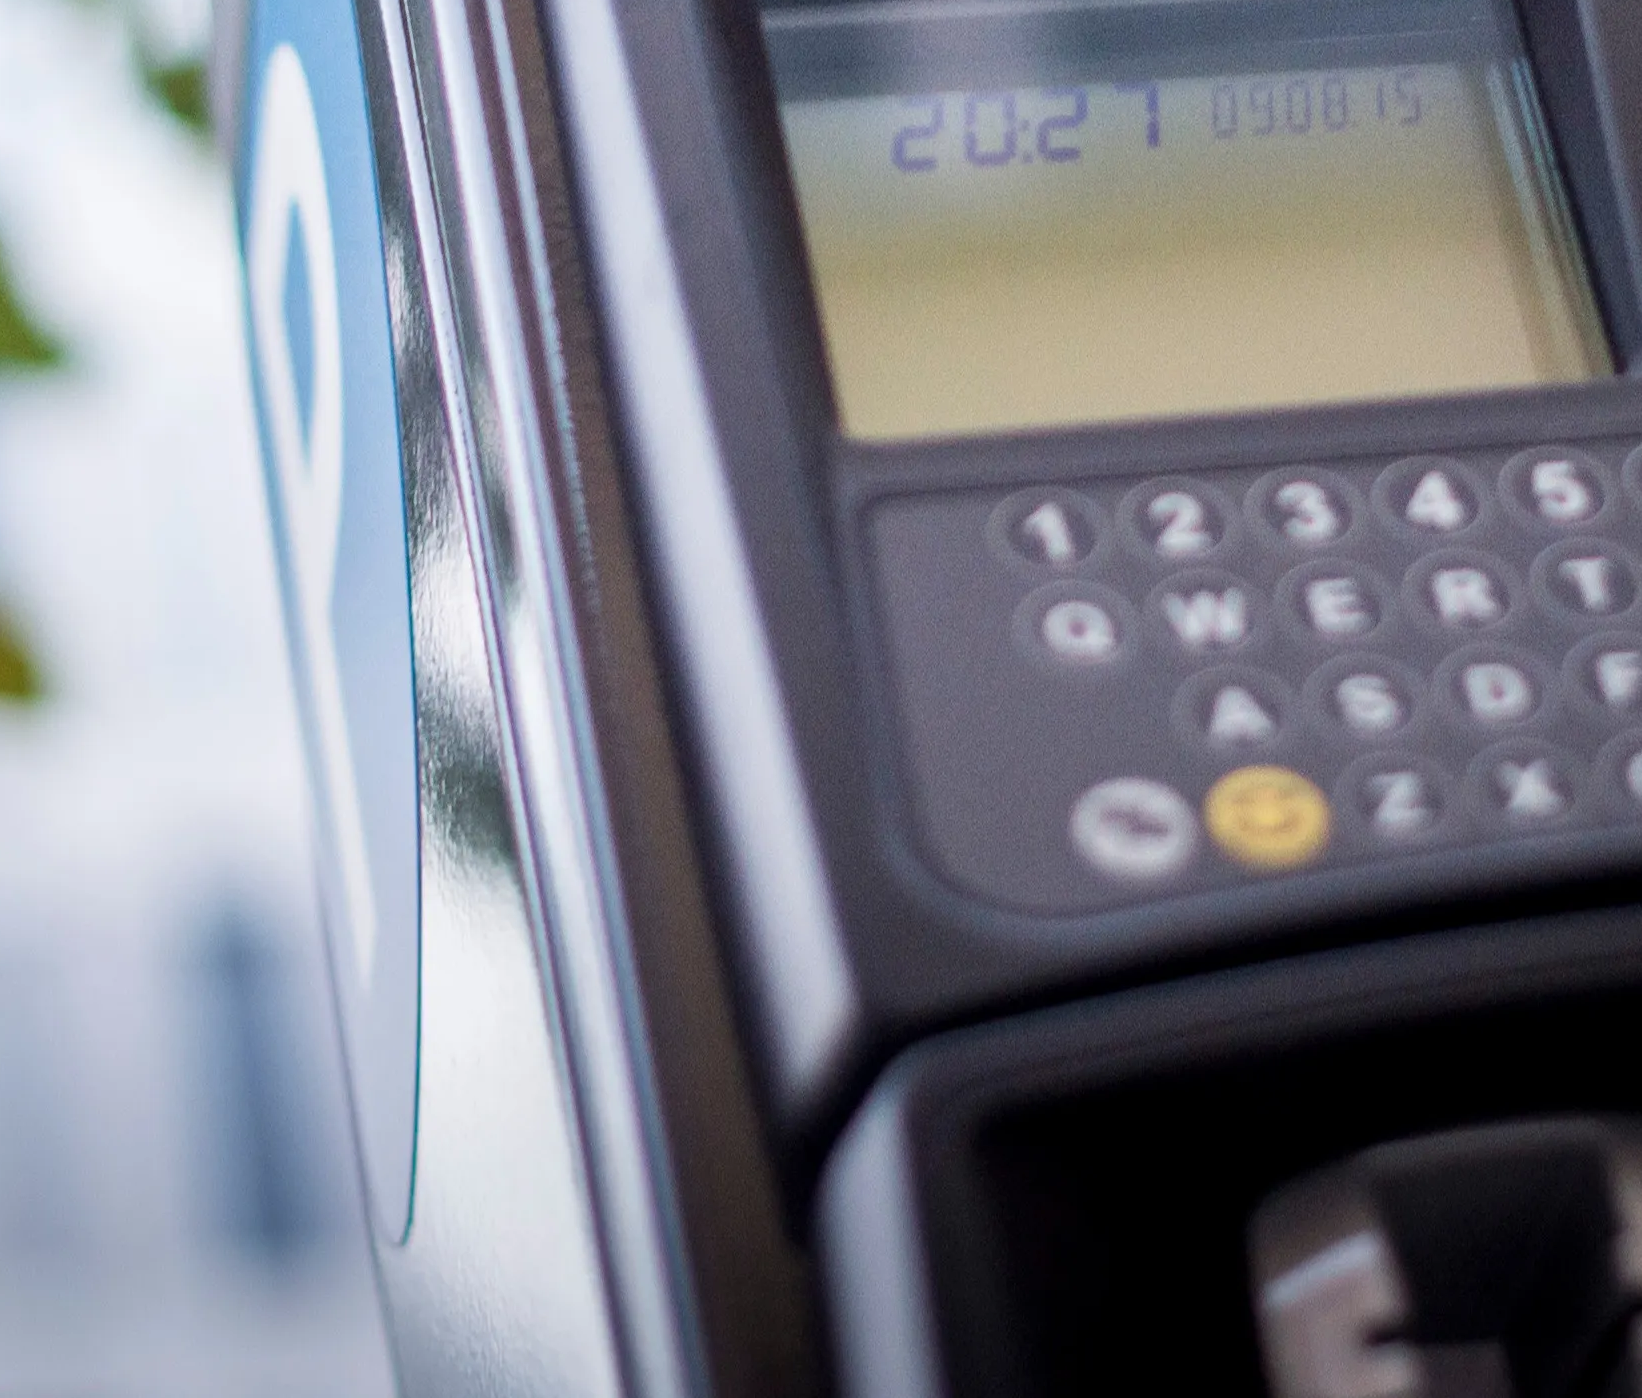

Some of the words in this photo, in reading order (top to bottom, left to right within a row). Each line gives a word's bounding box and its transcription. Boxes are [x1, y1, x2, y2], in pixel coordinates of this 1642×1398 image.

[1027, 502, 1074, 563] 1
[1151, 491, 1207, 558] 2
[1279, 481, 1337, 545] 3
[1408, 471, 1463, 530] 4
[1532, 459, 1590, 522] 5
[1044, 601, 1115, 660] Q
[1167, 592, 1245, 646] W
[1308, 578, 1363, 635] E
[1433, 568, 1496, 621] R
[1558, 559, 1607, 606] T
[1211, 687, 1271, 741] A
[1339, 674, 1398, 732] S
[1464, 662, 1530, 722] D
[1595, 652, 1641, 703] F
[1371, 770, 1424, 832] Z
[1500, 762, 1560, 816] X
